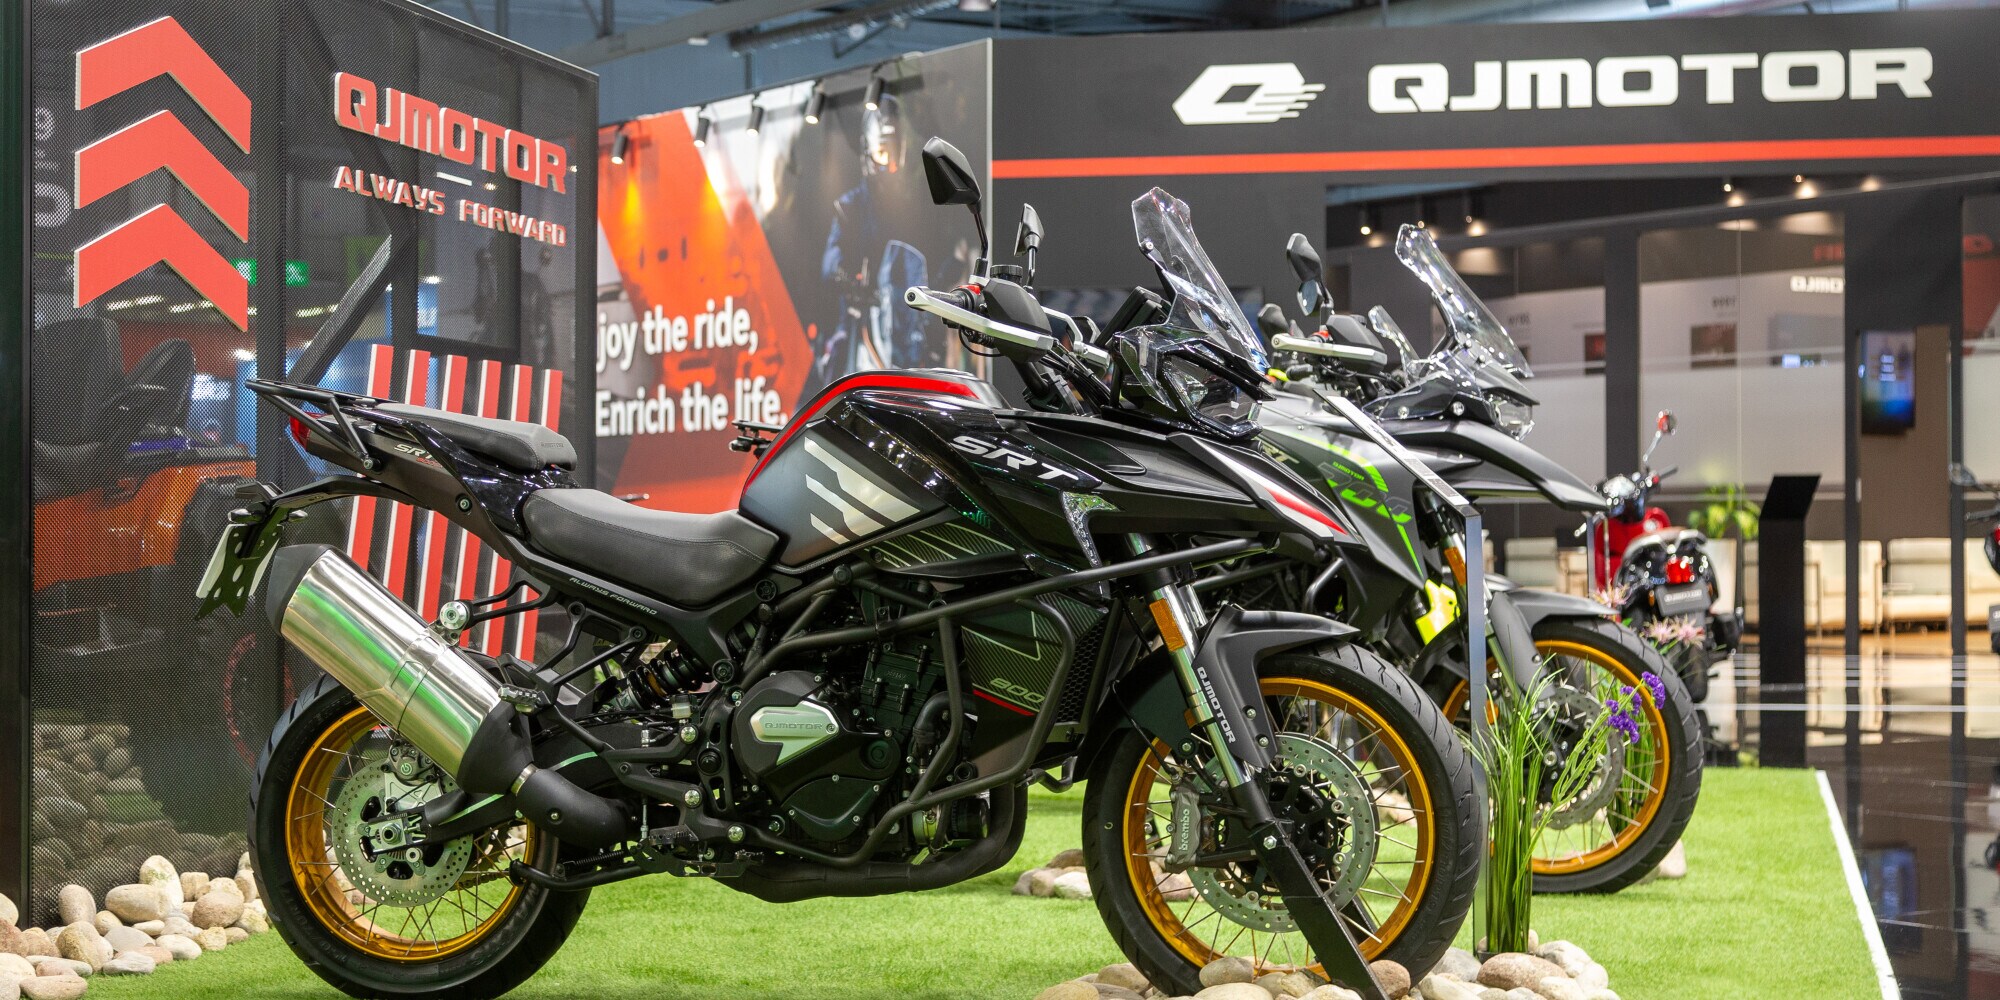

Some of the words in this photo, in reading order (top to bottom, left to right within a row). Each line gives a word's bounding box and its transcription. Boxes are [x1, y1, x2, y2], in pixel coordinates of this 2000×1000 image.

[1368, 47, 1934, 113] QJMOTOR
[334, 71, 567, 195] QJMOTOR
[334, 165, 446, 216] ALWAYS
[459, 199, 567, 247] FORWARD
[642, 304, 689, 355] the
[694, 295, 759, 356] ride,
[596, 384, 676, 437] Enrich
[680, 381, 729, 432] the
[734, 375, 789, 426] life.
[950, 435, 1080, 480] SRT
[569, 577, 610, 596] ALWAYS
[609, 593, 658, 615] FORWARD
[989, 677, 1046, 704] 800
[1196, 665, 1237, 744] QJMOTOR
[764, 722, 823, 730] QJMOTOR
[1178, 807, 1191, 852] brembo
